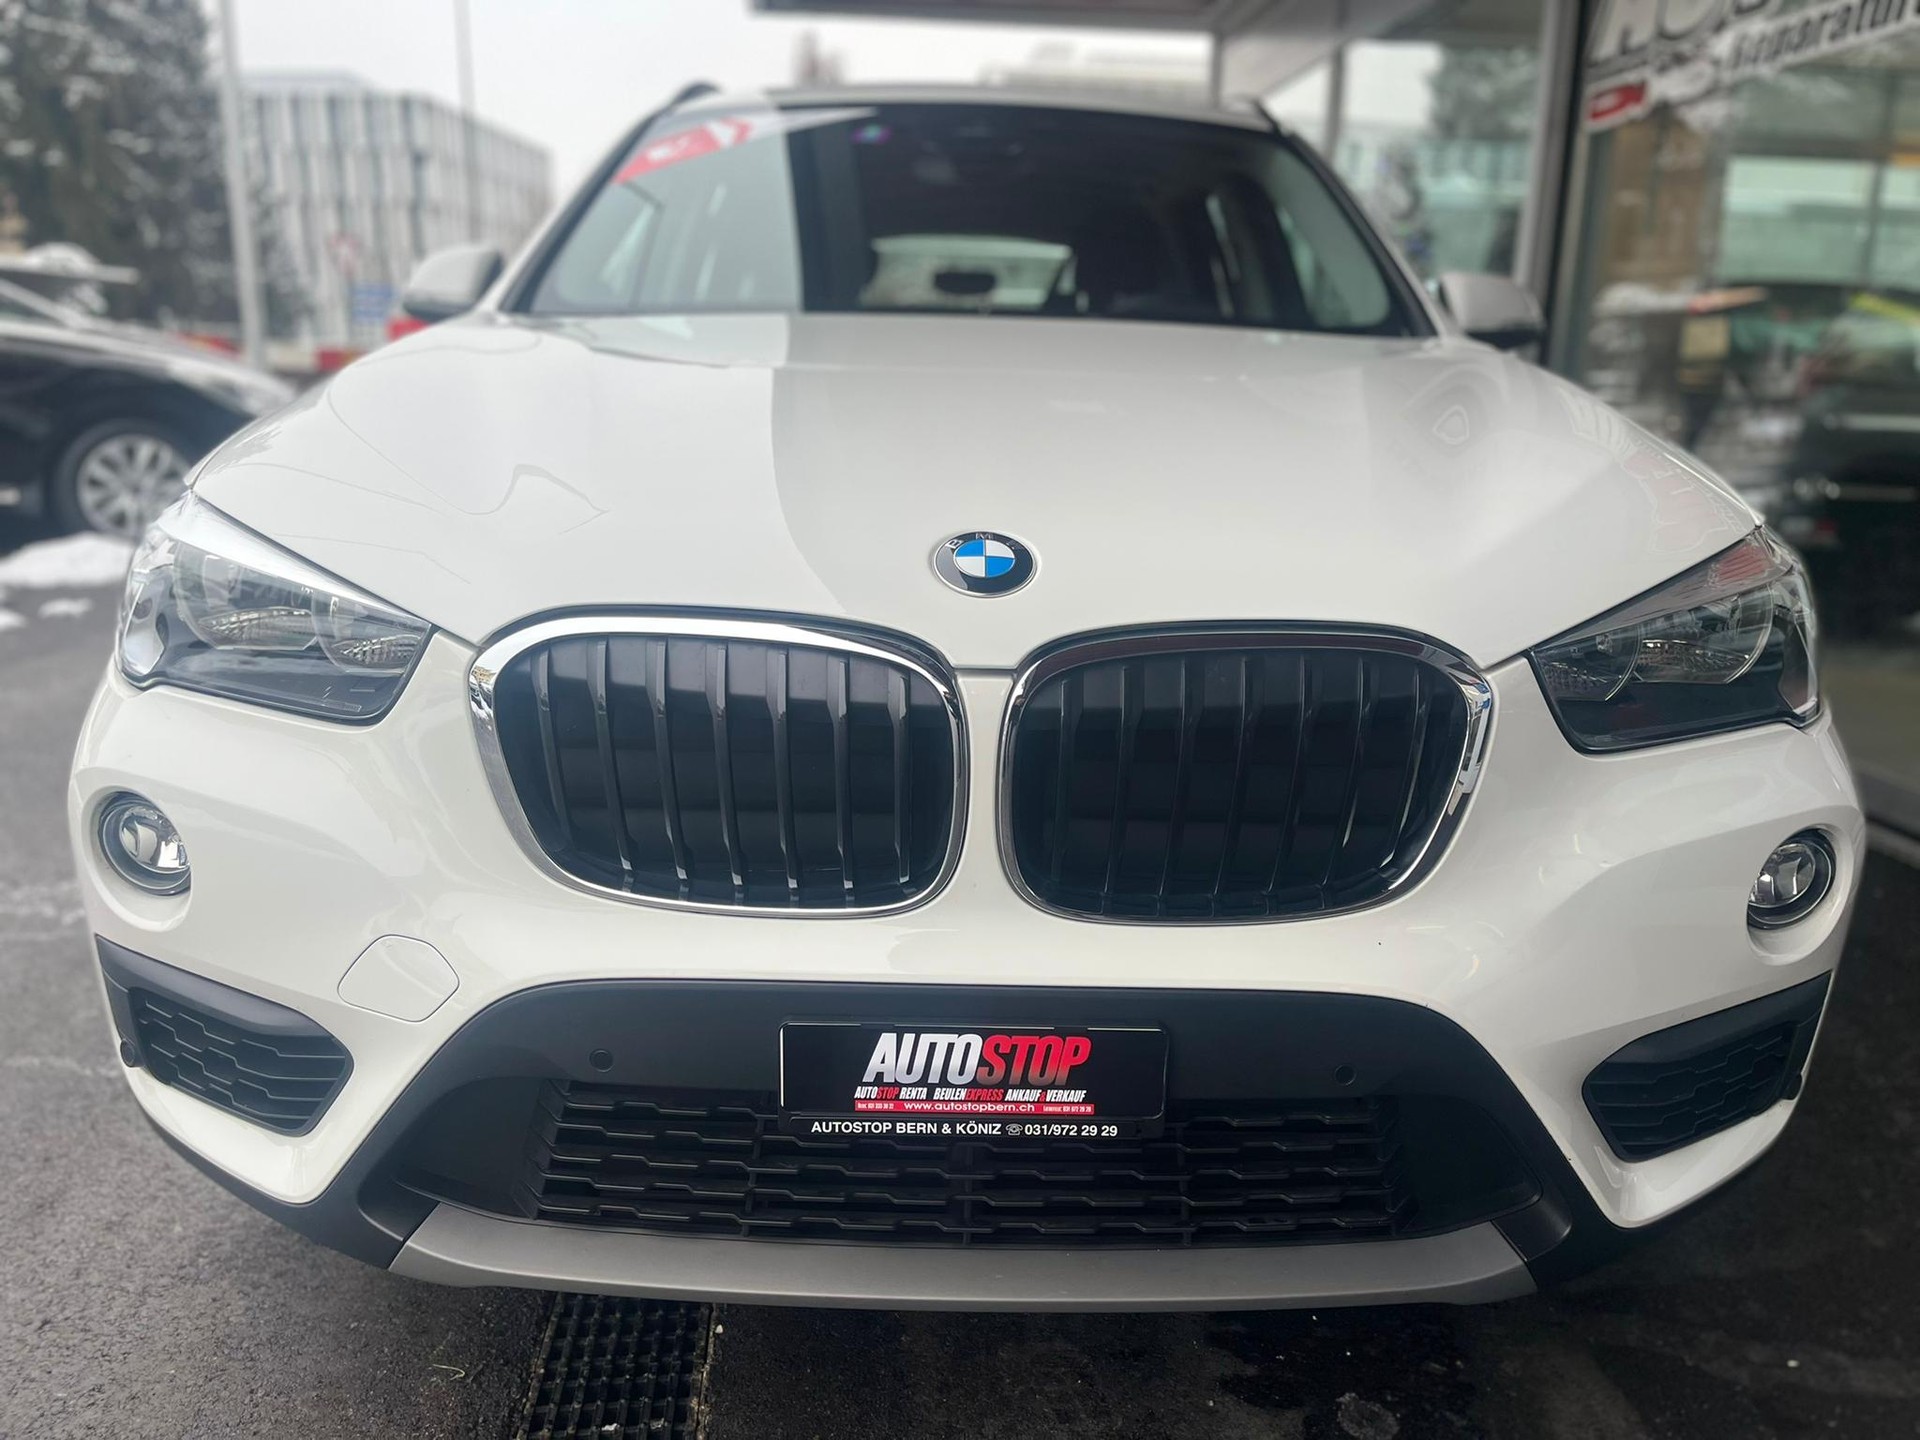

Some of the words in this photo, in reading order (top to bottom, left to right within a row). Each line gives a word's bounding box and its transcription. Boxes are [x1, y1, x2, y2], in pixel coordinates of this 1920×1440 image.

[862, 1032, 1092, 1086] AUTOSTOP
[853, 1086, 900, 1099] AUTOSTOP
[899, 1087, 928, 1100] RENTA
[904, 1102, 1035, 1113] www.autostopbern.ch
[811, 1121, 892, 1133] AUTOSTOP
[896, 1122, 937, 1134] BERN
[941, 1123, 952, 1134] &
[956, 1120, 1002, 1135] KÖNIZ
[1024, 1123, 1078, 1136] 031/972
[1081, 1124, 1098, 1136] 29
[1101, 1124, 1118, 1137] 29
